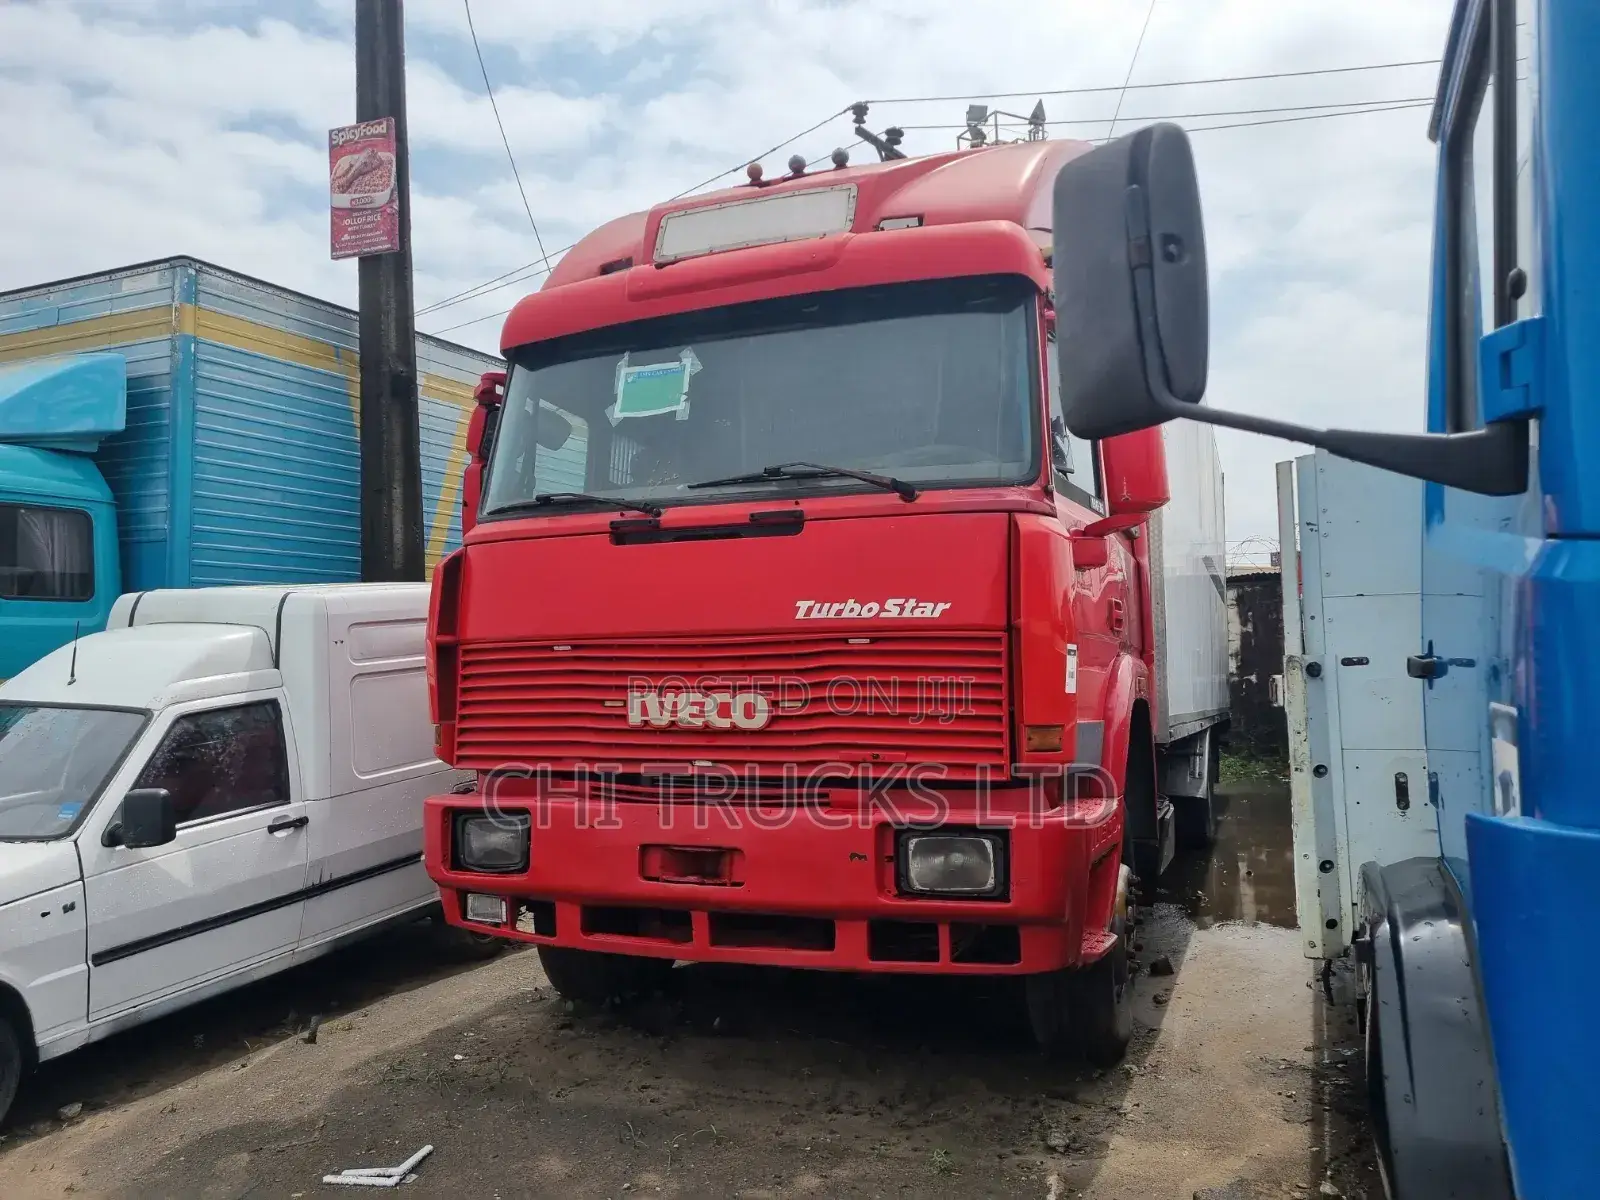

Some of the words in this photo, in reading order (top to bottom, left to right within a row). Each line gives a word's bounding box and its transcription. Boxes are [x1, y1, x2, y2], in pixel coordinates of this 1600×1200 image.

[331, 120, 387, 146] SpicyFood
[341, 216, 366, 226] JOLLOF
[366, 213, 382, 223] RICE
[627, 689, 772, 731] IVECO
